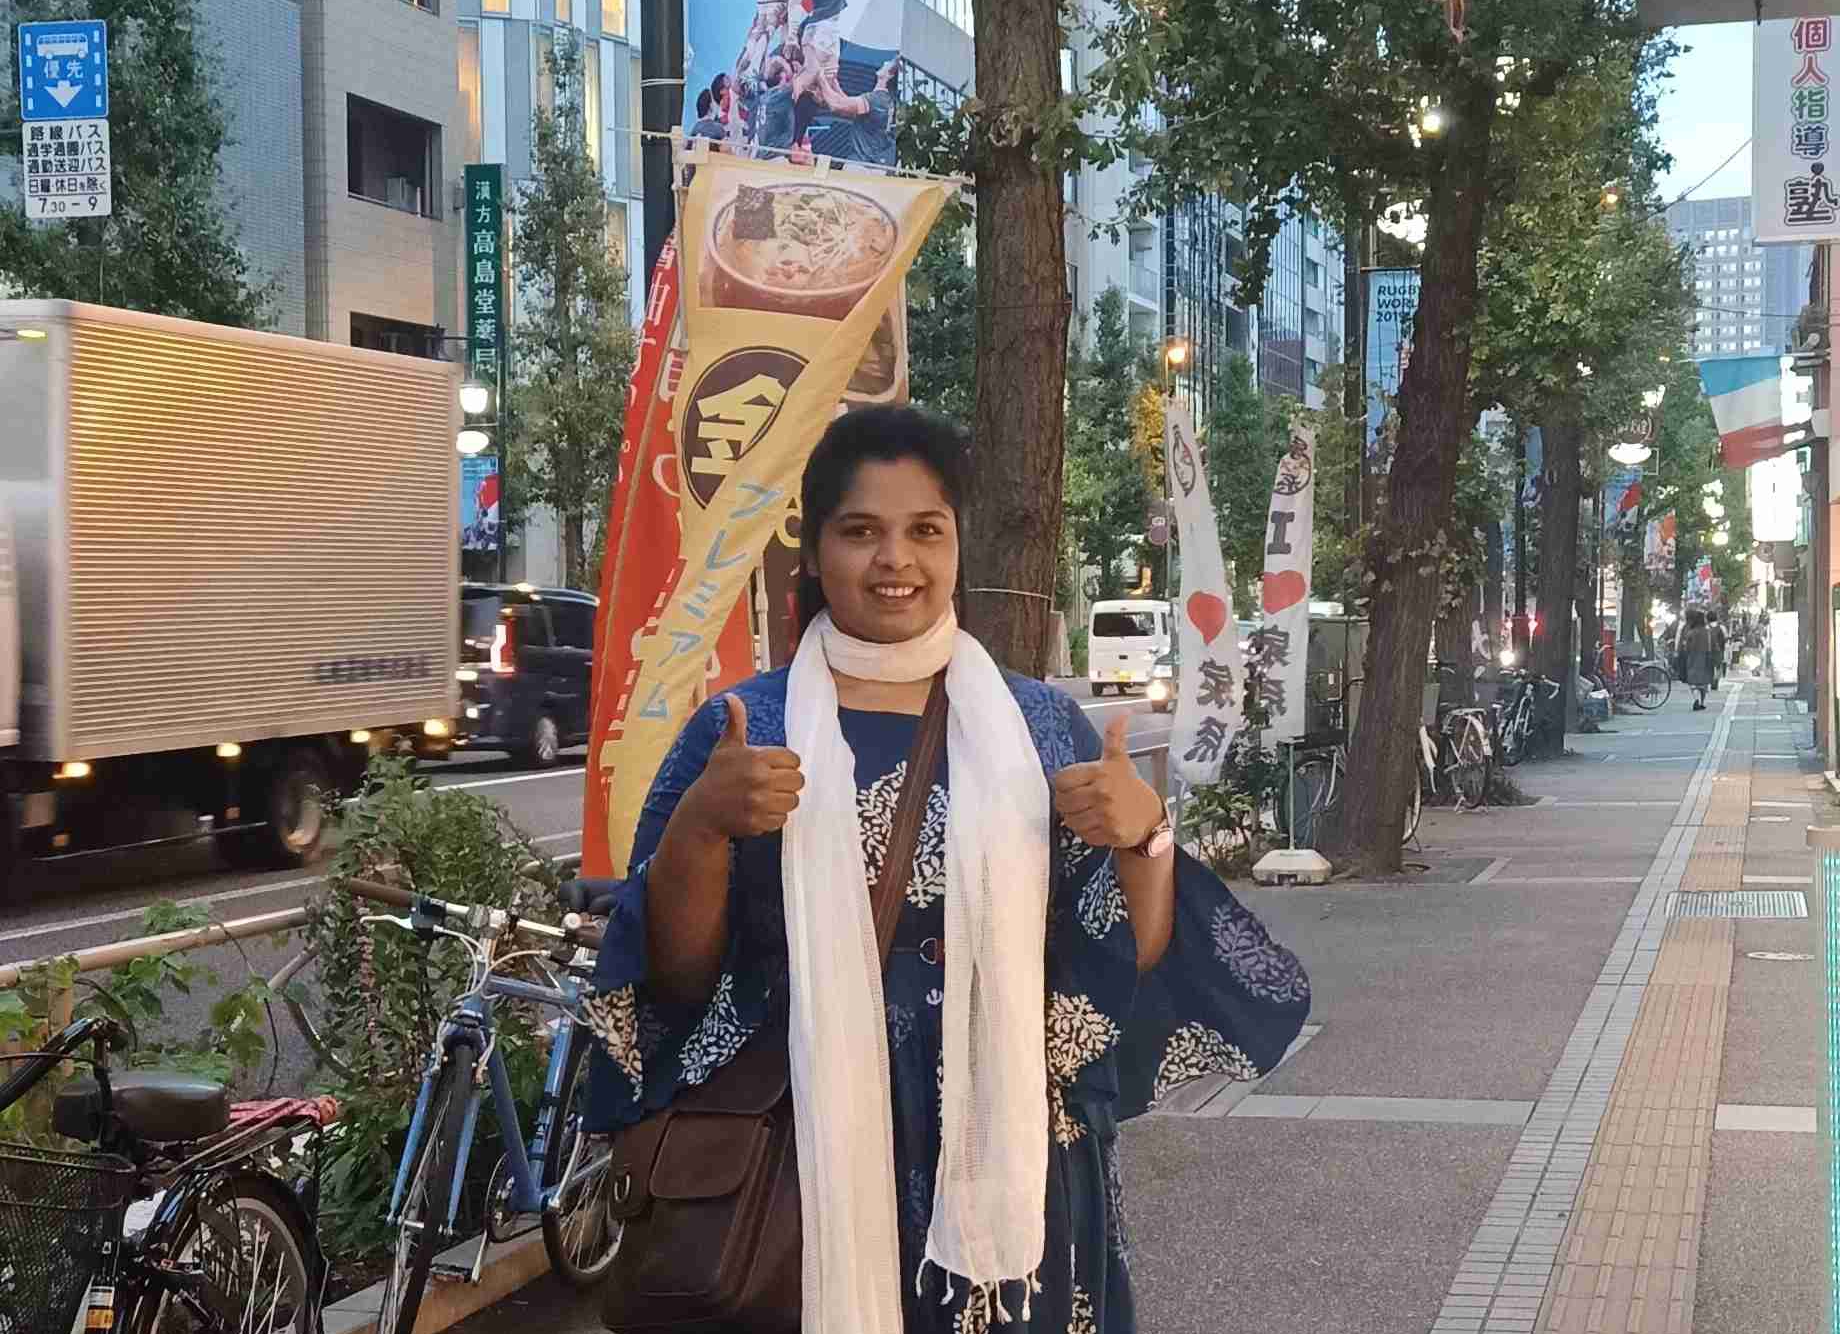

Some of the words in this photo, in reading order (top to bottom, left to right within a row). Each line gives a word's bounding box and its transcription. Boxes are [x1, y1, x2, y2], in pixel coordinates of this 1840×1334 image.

[44, 59, 84, 79] 優先
[30, 124, 101, 141] 路線バス
[28, 157, 106, 174] 通勤送迎バス
[1377, 298, 1417, 309] WORL
